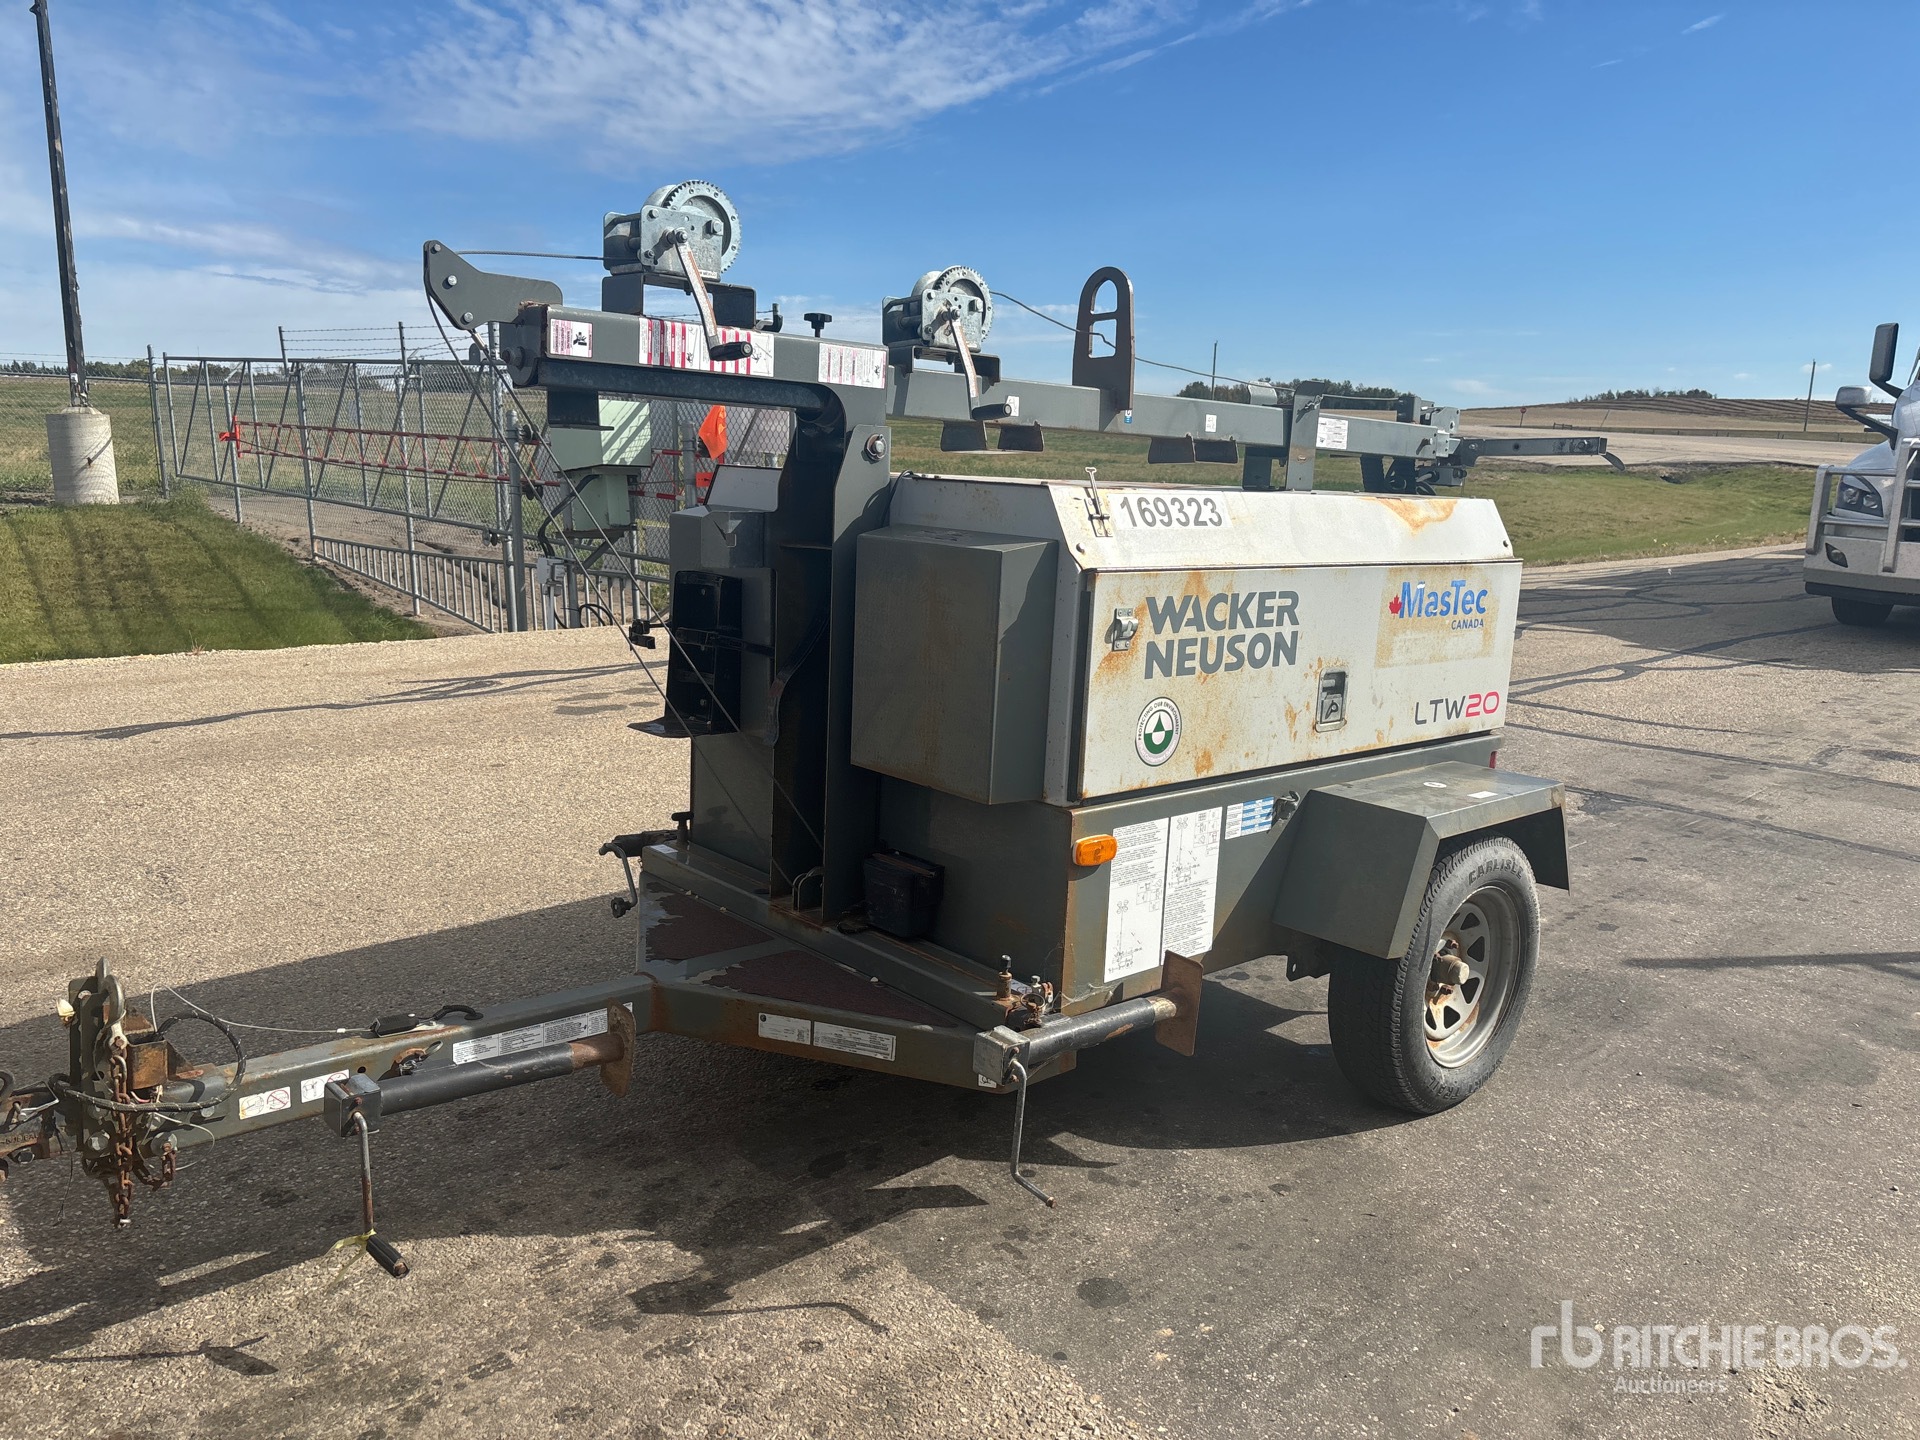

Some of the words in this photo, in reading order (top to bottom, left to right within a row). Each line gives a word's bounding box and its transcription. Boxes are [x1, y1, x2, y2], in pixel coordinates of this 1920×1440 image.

[1120, 496, 1222, 527] 169323
[1145, 590, 1300, 634] WACKER
[1399, 580, 1488, 618] MasTec
[1451, 618, 1484, 630] CANADA
[1144, 630, 1299, 679] NEUSON
[1138, 706, 1154, 741] PROTECTING
[1163, 701, 1179, 735] ENVIRONMENT
[1415, 691, 1500, 725] LTW20
[1468, 859, 1523, 885] CARLISLE
